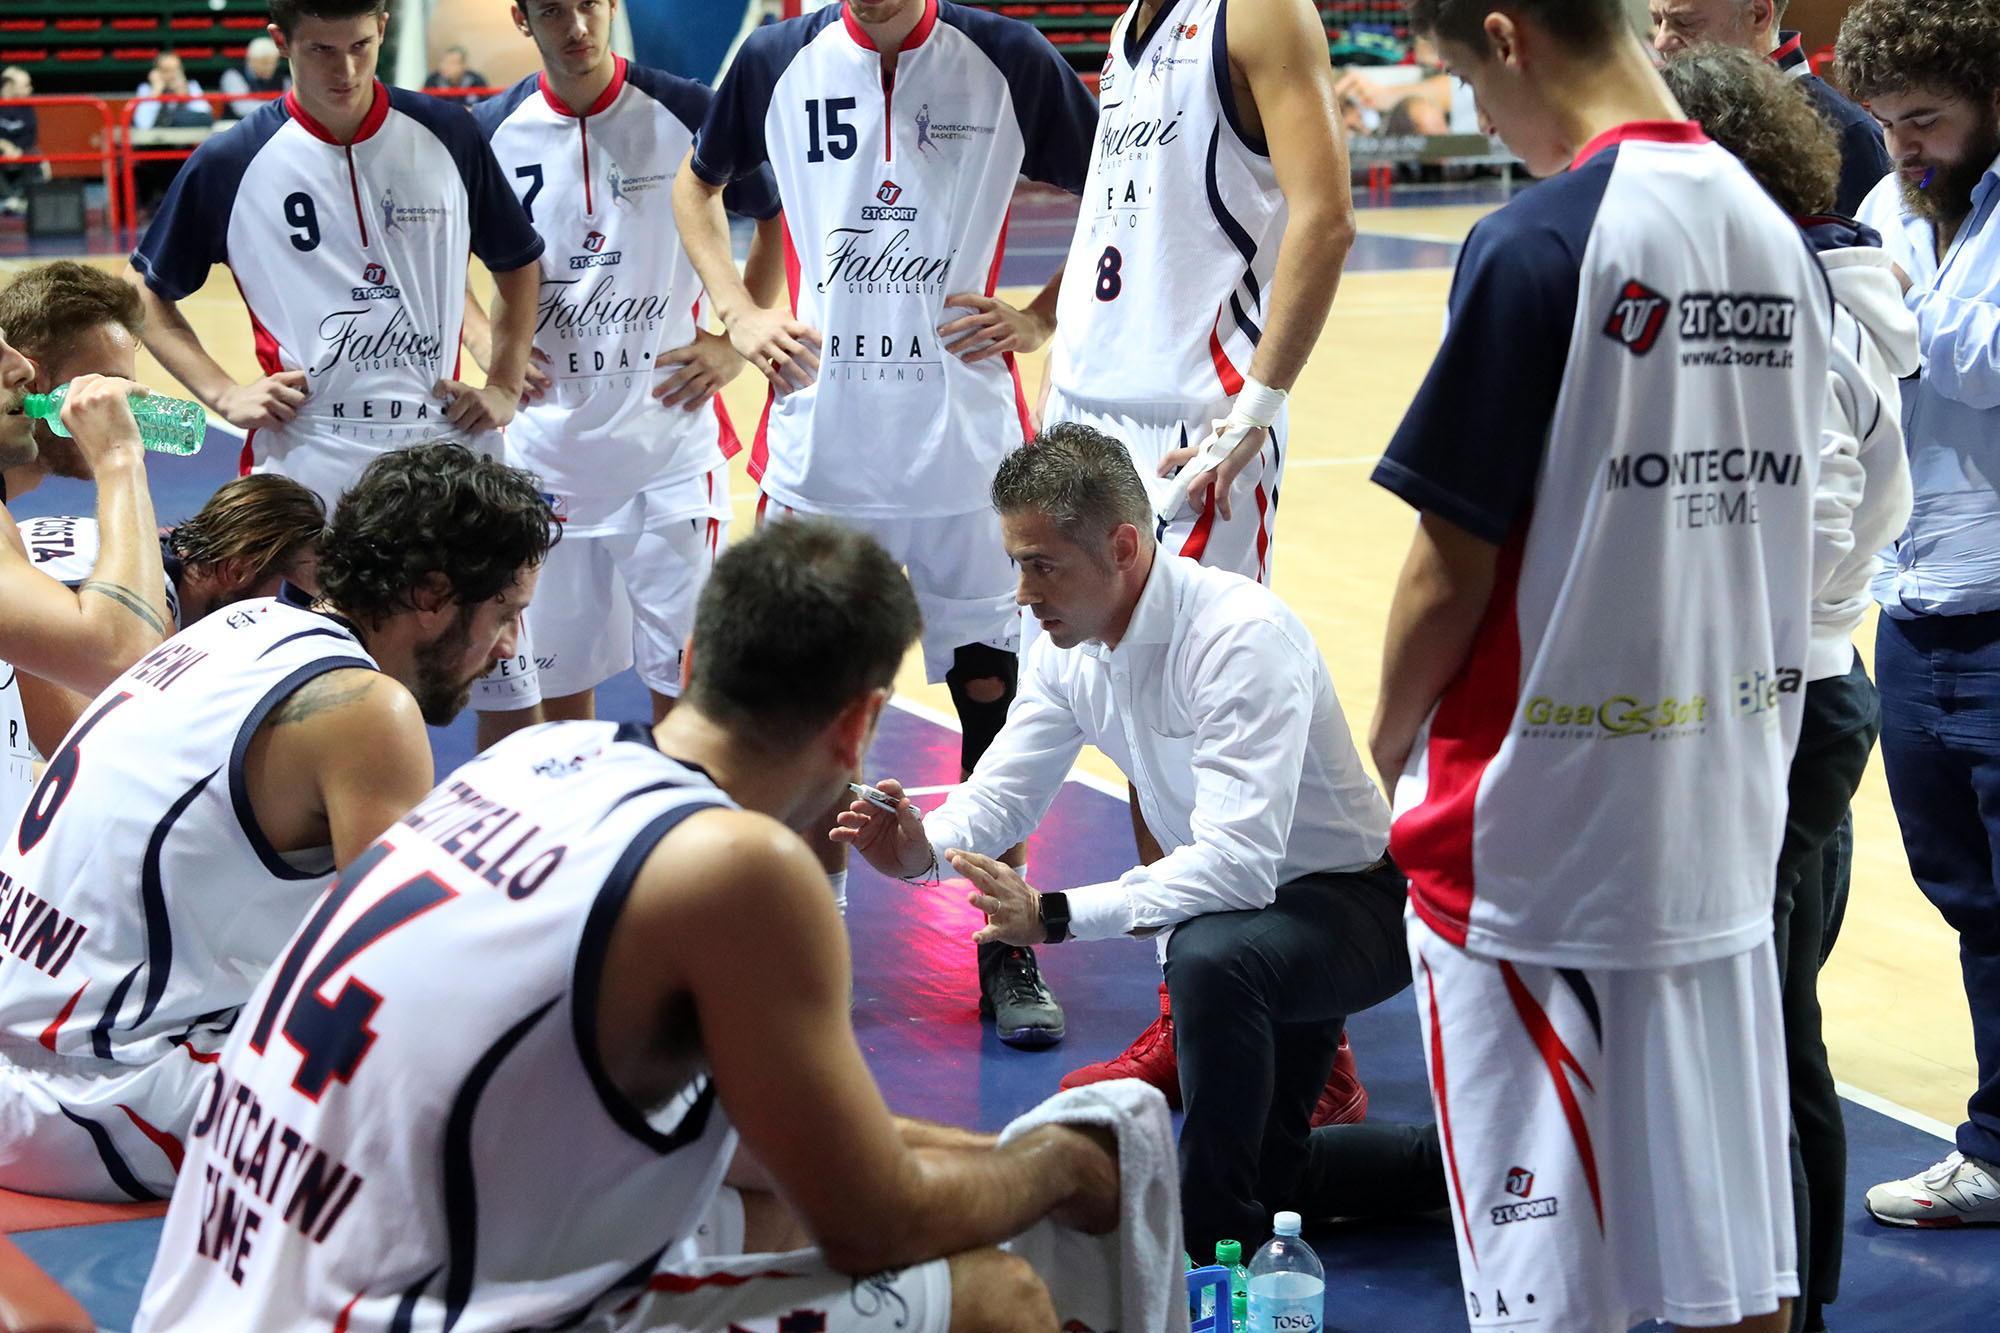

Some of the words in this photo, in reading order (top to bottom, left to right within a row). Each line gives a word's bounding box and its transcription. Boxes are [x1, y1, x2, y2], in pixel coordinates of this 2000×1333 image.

[805, 97, 858, 163] 15
[515, 164, 544, 224] 7
[284, 192, 321, 252] 9
[862, 206, 880, 220] 2T
[879, 206, 917, 220] SPORT
[586, 251, 622, 267] SPORT
[1095, 245, 1123, 302] 8
[535, 275, 672, 334] Fabiani
[1680, 293, 1715, 340] 2T
[831, 335, 922, 357] REDA
[569, 348, 629, 373] EDA
[830, 367, 924, 382] MILANO
[333, 400, 428, 419] REDA
[333, 424, 431, 440] MILANO
[250, 839, 461, 1105] 14
[1512, 1197, 1558, 1221] SPORT
[1272, 1314, 1316, 1330] TOSCA
